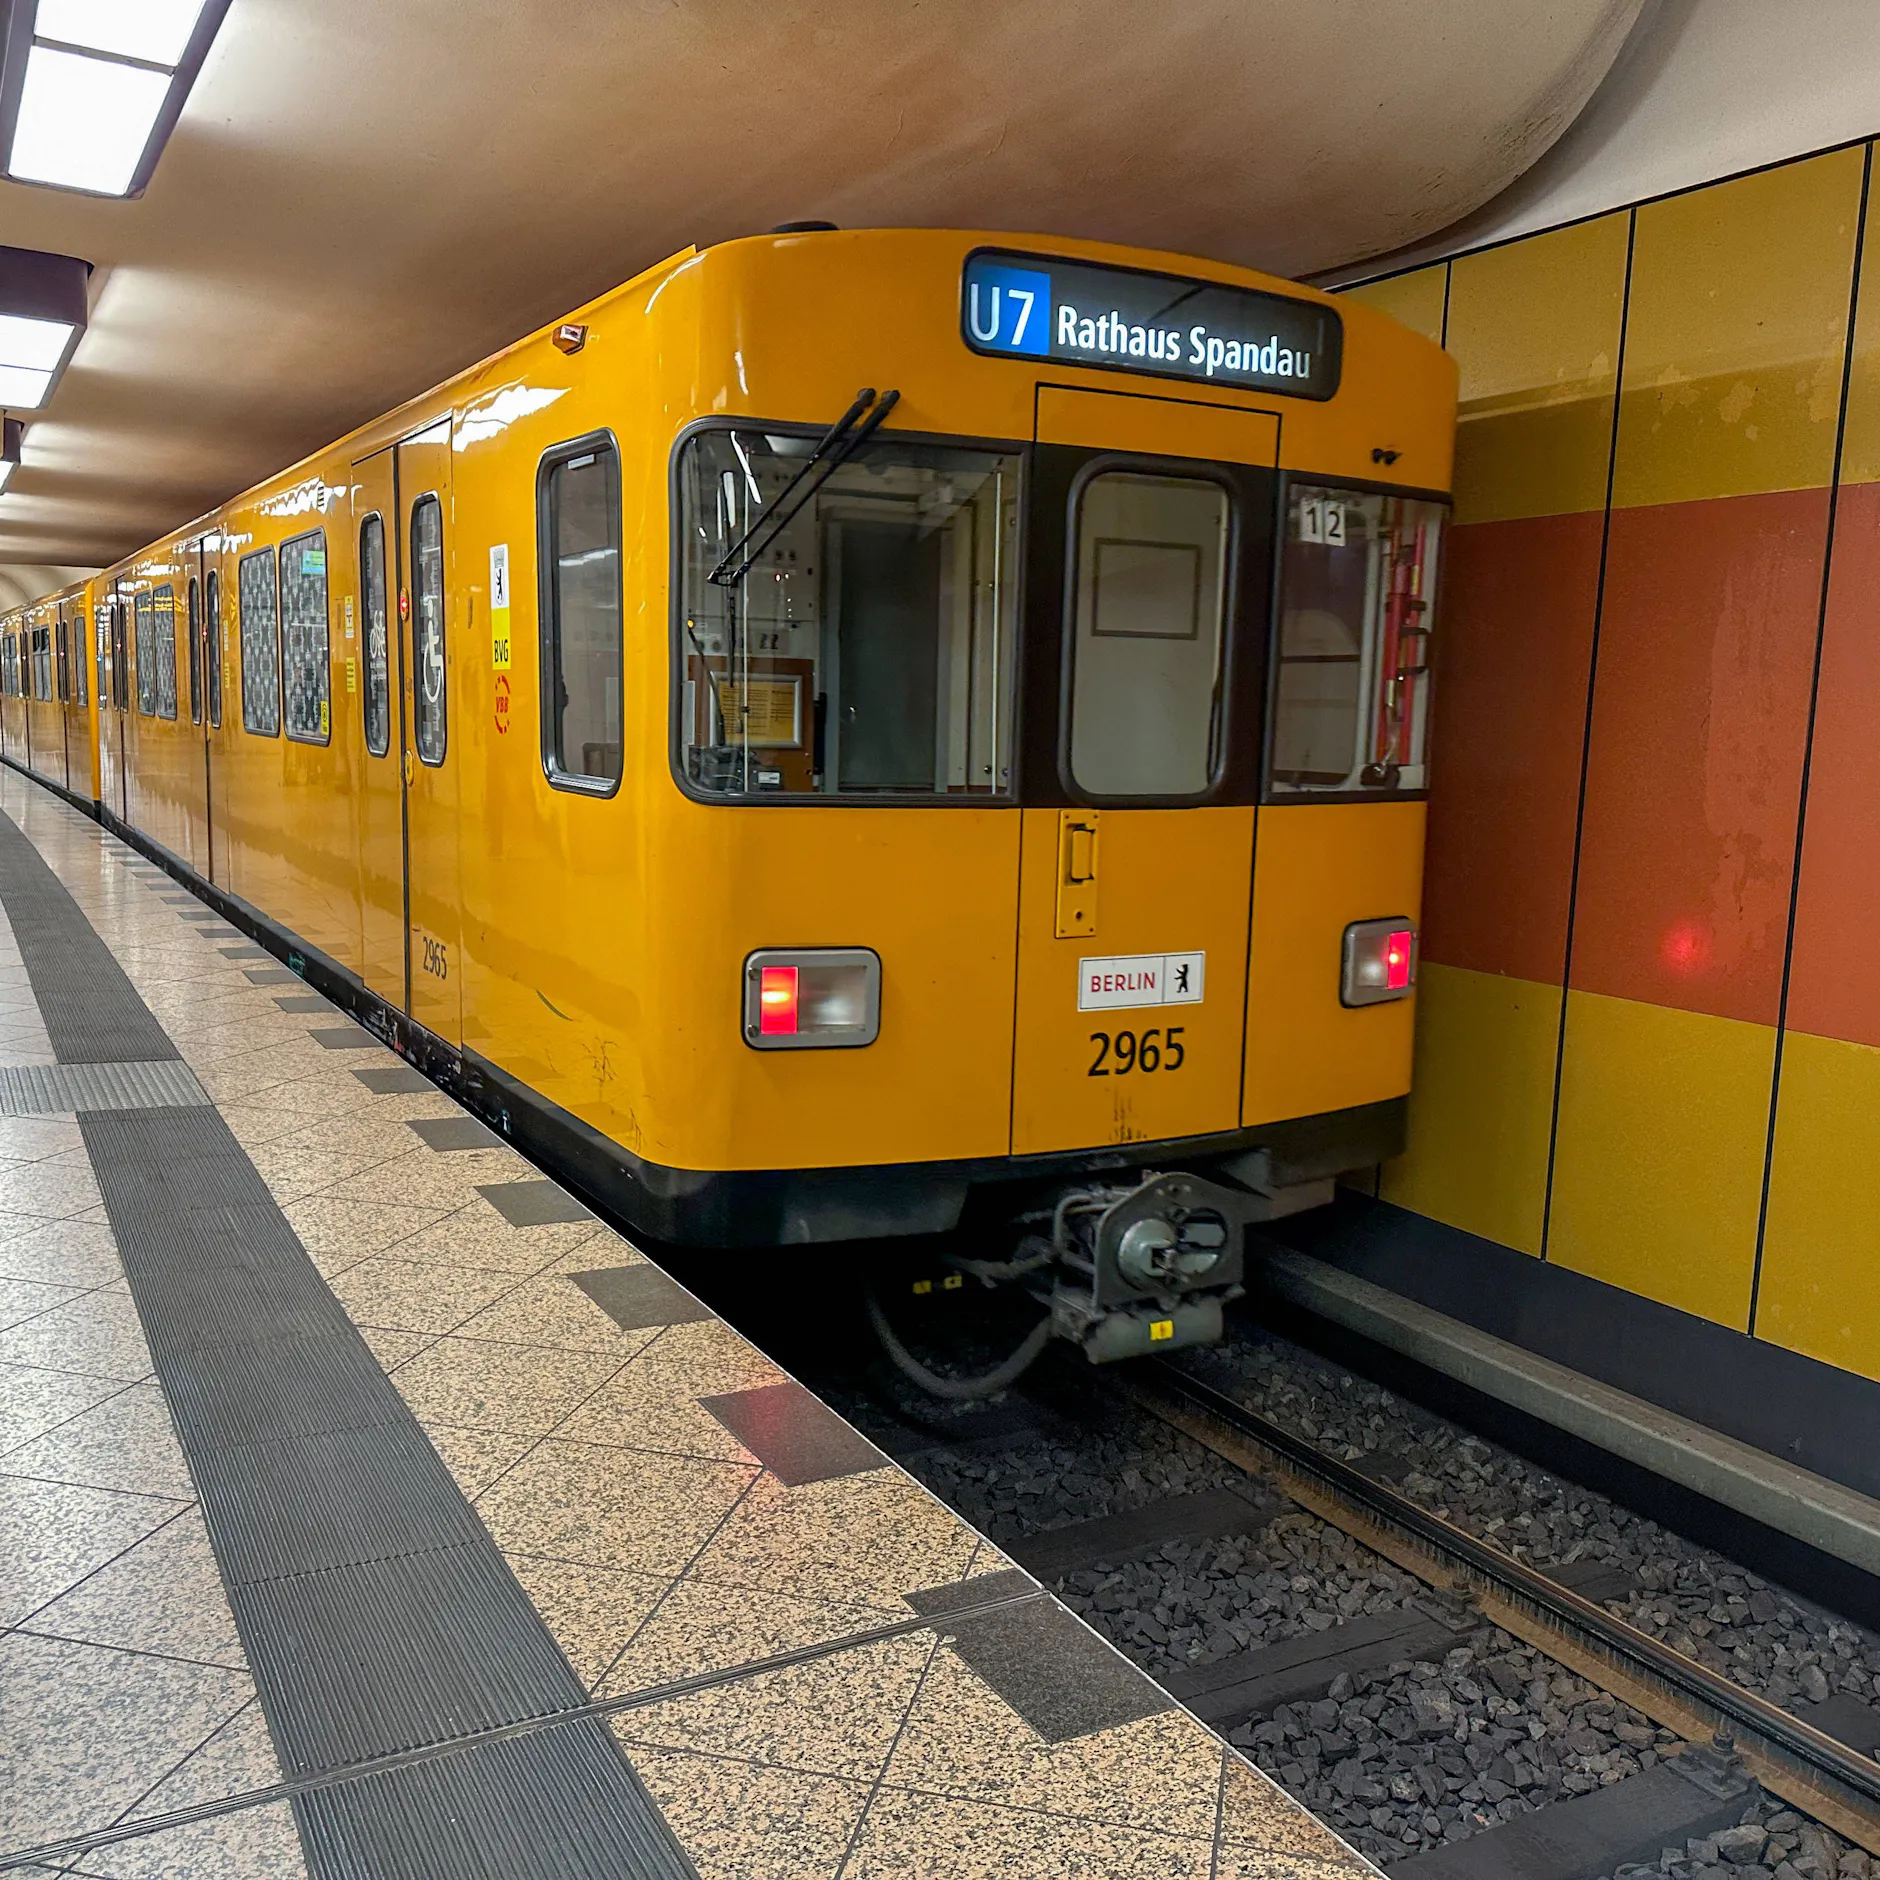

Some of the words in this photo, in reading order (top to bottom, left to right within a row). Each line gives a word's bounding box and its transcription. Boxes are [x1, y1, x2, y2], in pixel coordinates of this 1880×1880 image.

[1057, 305, 1181, 361] Rathaus
[1189, 327, 1310, 379] Spandau
[494, 639, 509, 662] BVG
[496, 697, 508, 713] VBB
[423, 936, 447, 980] 2965
[1091, 972, 1155, 992] BERLIN
[1088, 1027, 1185, 1076] 2965
